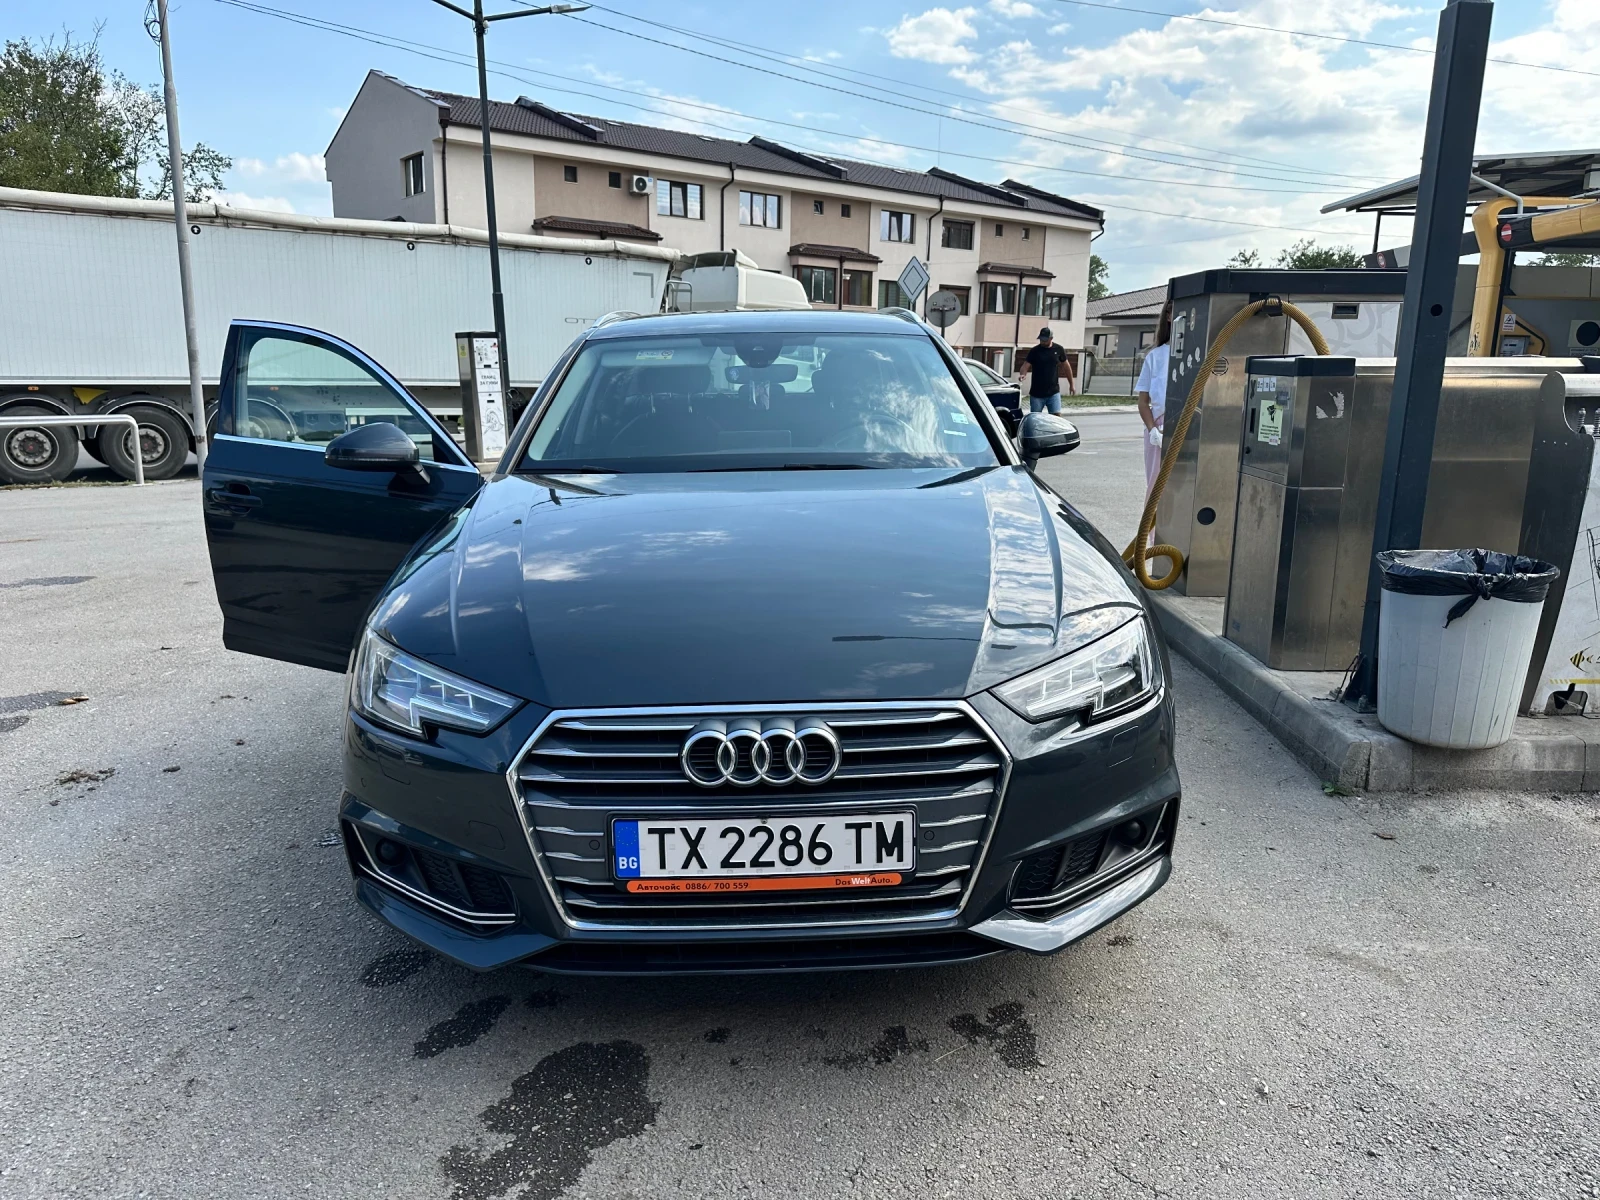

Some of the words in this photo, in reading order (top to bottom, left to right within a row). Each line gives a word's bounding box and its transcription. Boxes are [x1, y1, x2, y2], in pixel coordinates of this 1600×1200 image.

[647, 826, 709, 870] TX
[719, 823, 833, 869] 2286
[845, 820, 904, 865] TM
[618, 856, 638, 870] BG
[636, 882, 681, 891] Авточойс
[714, 882, 730, 890] 700
[732, 881, 749, 889] 559
